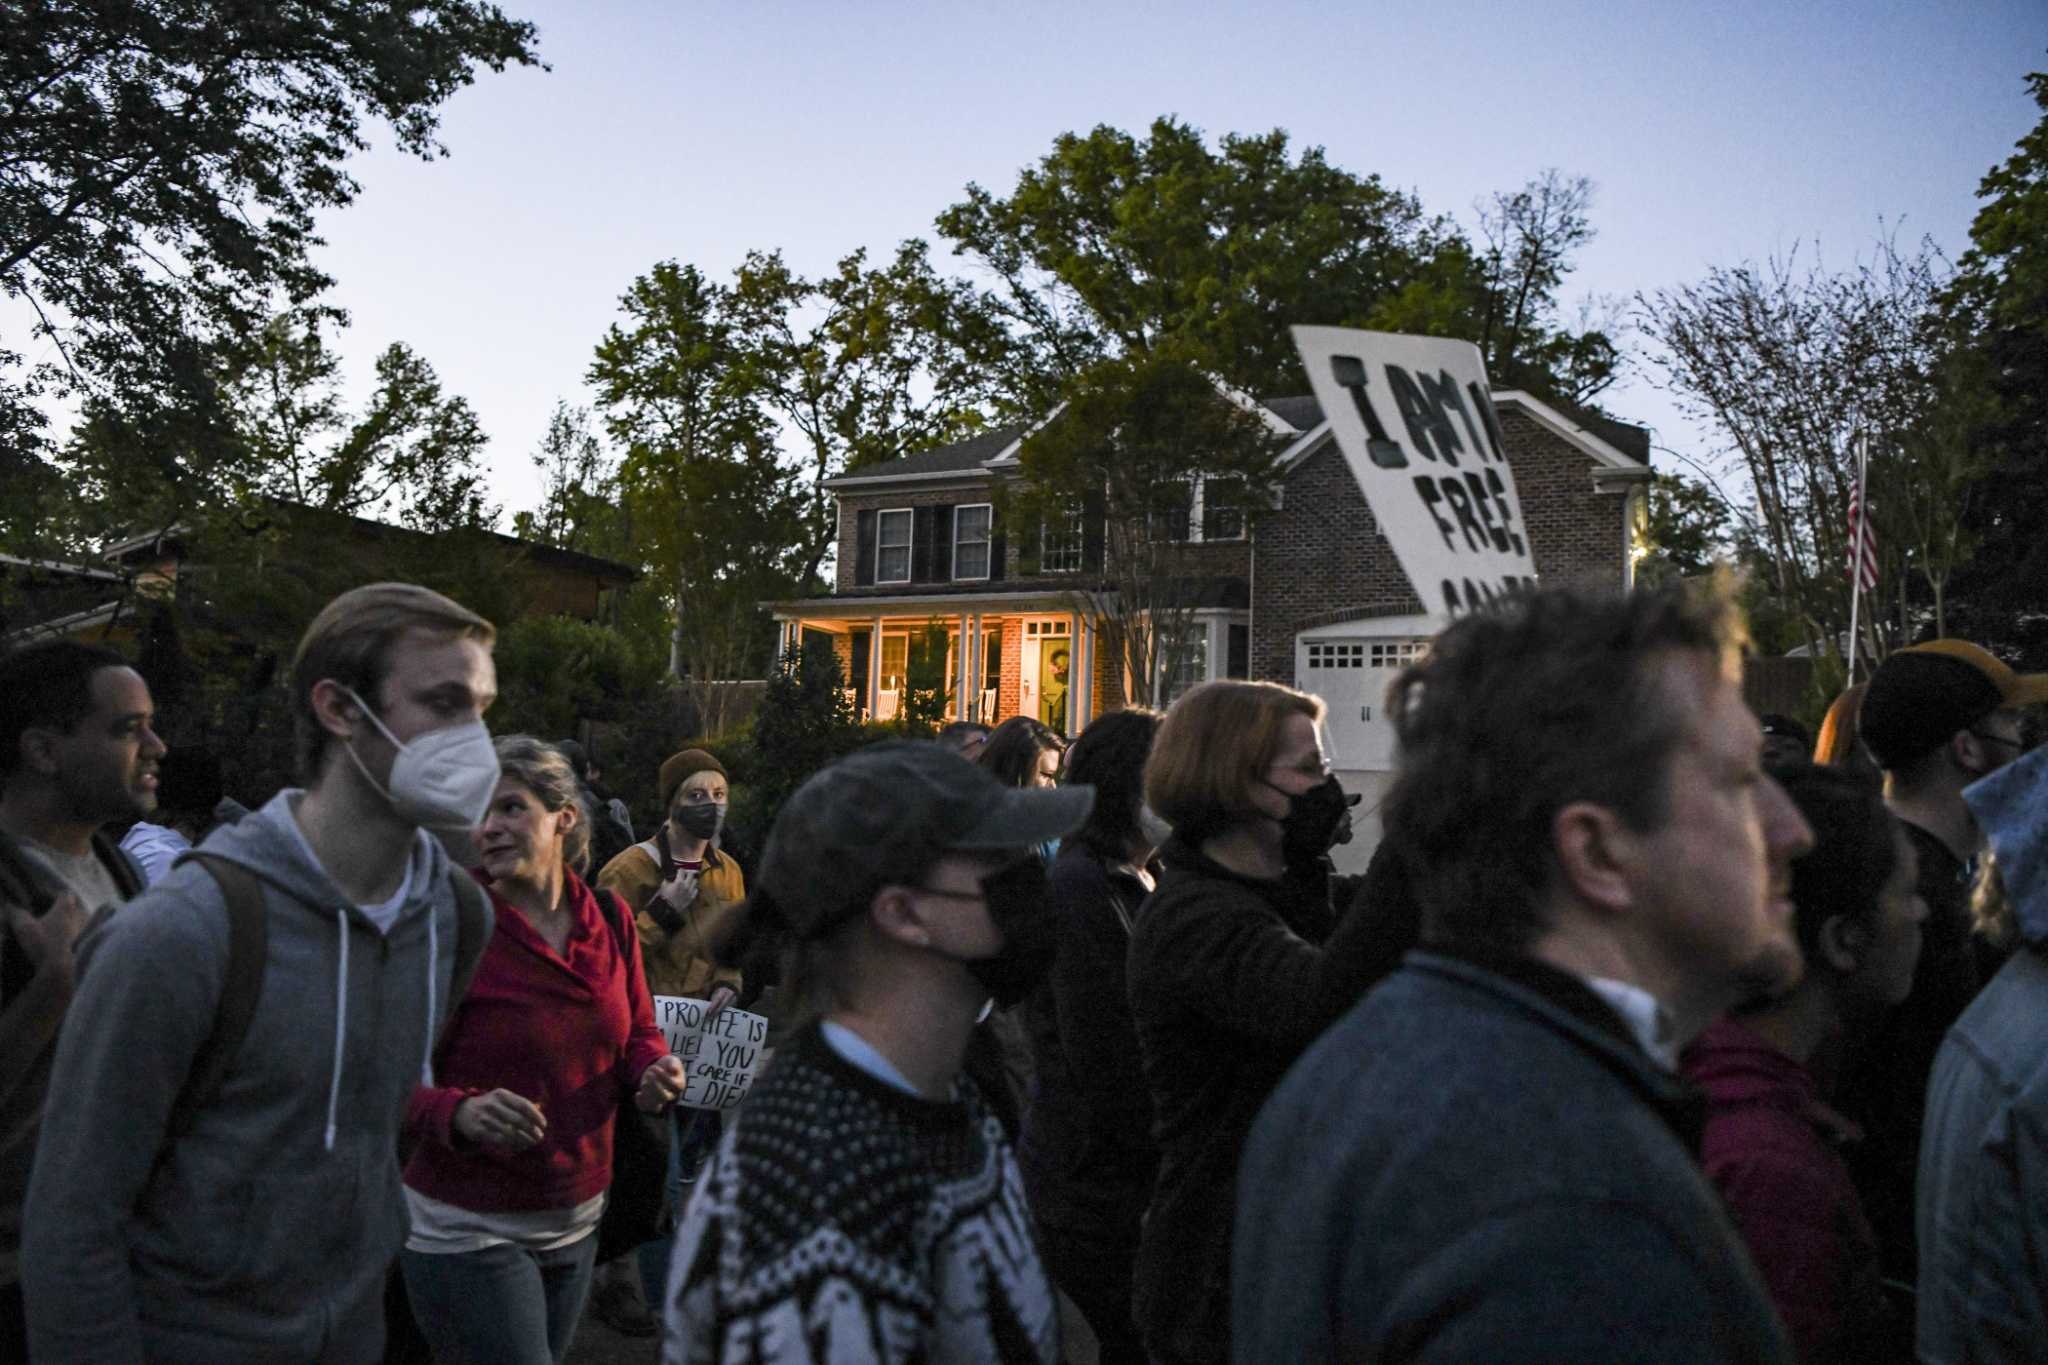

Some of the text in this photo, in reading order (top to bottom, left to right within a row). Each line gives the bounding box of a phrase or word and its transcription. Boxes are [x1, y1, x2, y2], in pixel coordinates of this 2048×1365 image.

[1328, 354, 1409, 469] I
[1384, 362, 1489, 468] AM
[1412, 466, 1526, 558] FREE
[747, 1019, 765, 1043] IS
[716, 1040, 756, 1070] YOU
[697, 1063, 732, 1082] CARE
[735, 1073, 750, 1087] IF
